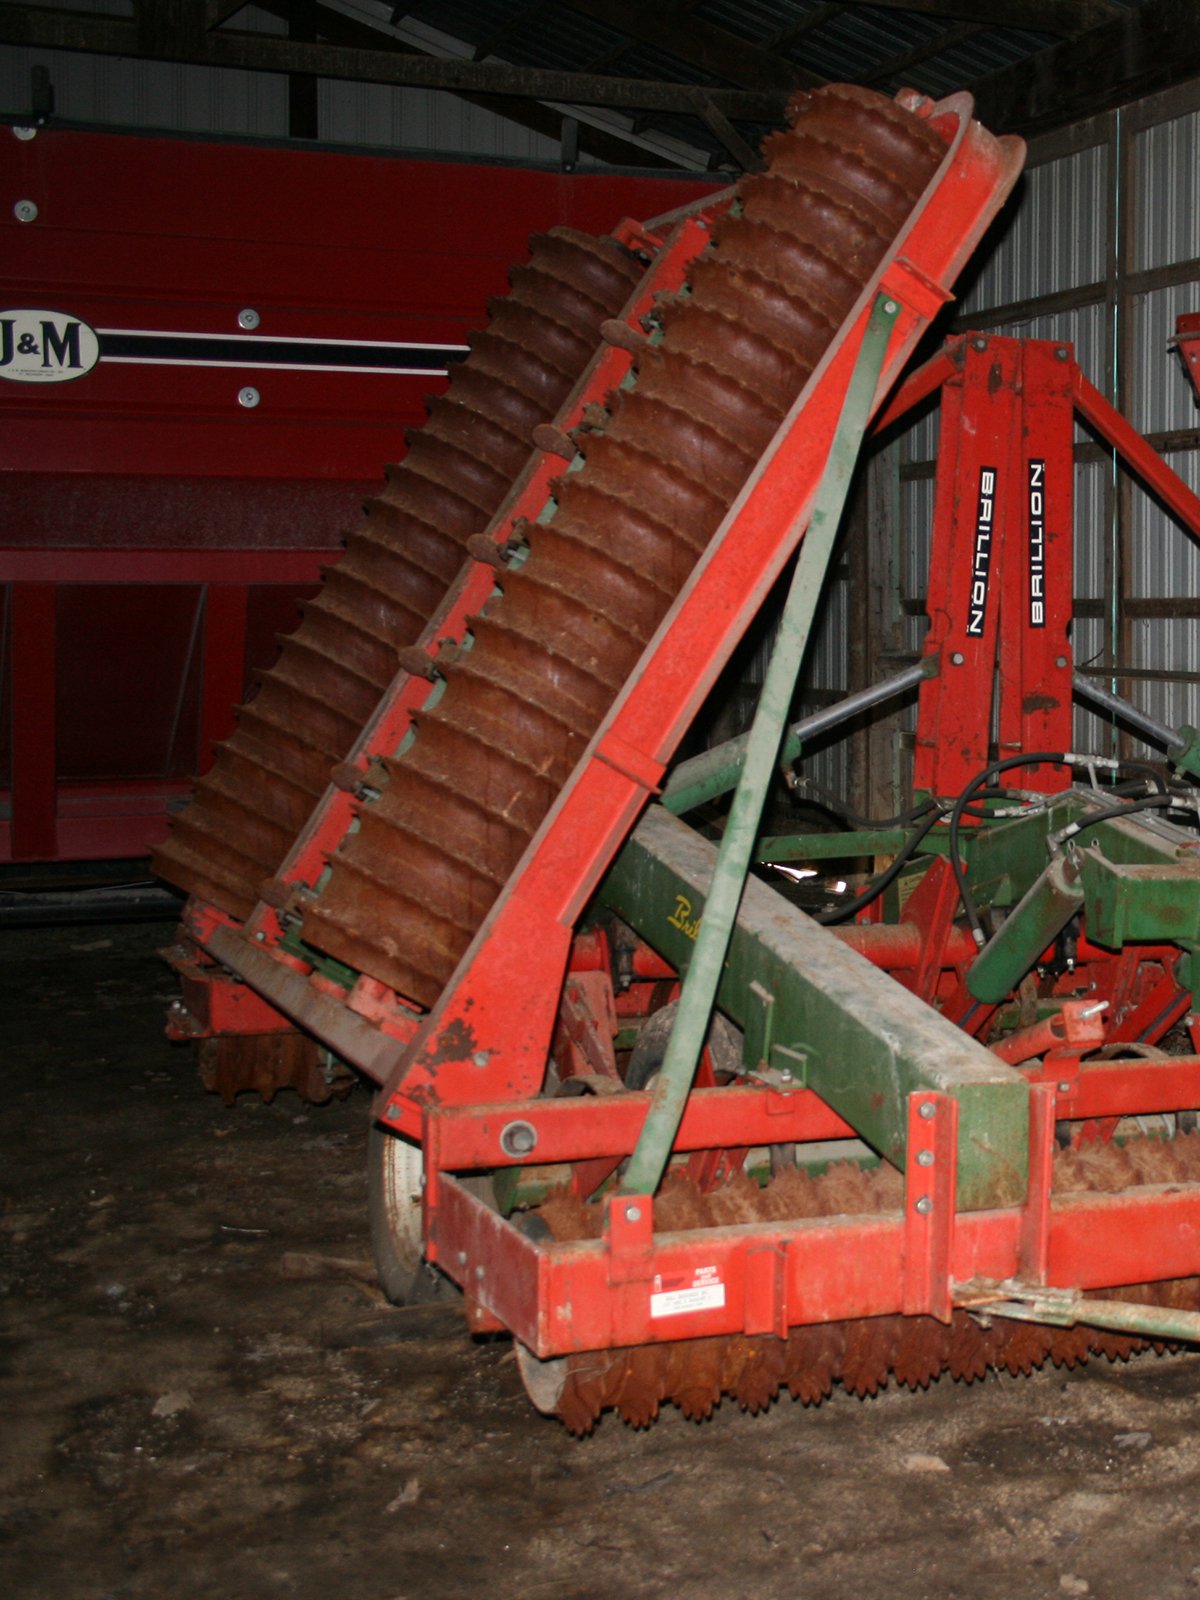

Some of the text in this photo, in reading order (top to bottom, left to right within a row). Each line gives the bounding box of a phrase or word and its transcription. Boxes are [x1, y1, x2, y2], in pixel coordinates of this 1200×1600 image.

[0, 319, 84, 368] J&M
[970, 471, 994, 633] BRILLION
[1030, 464, 1043, 624] BRILLION
